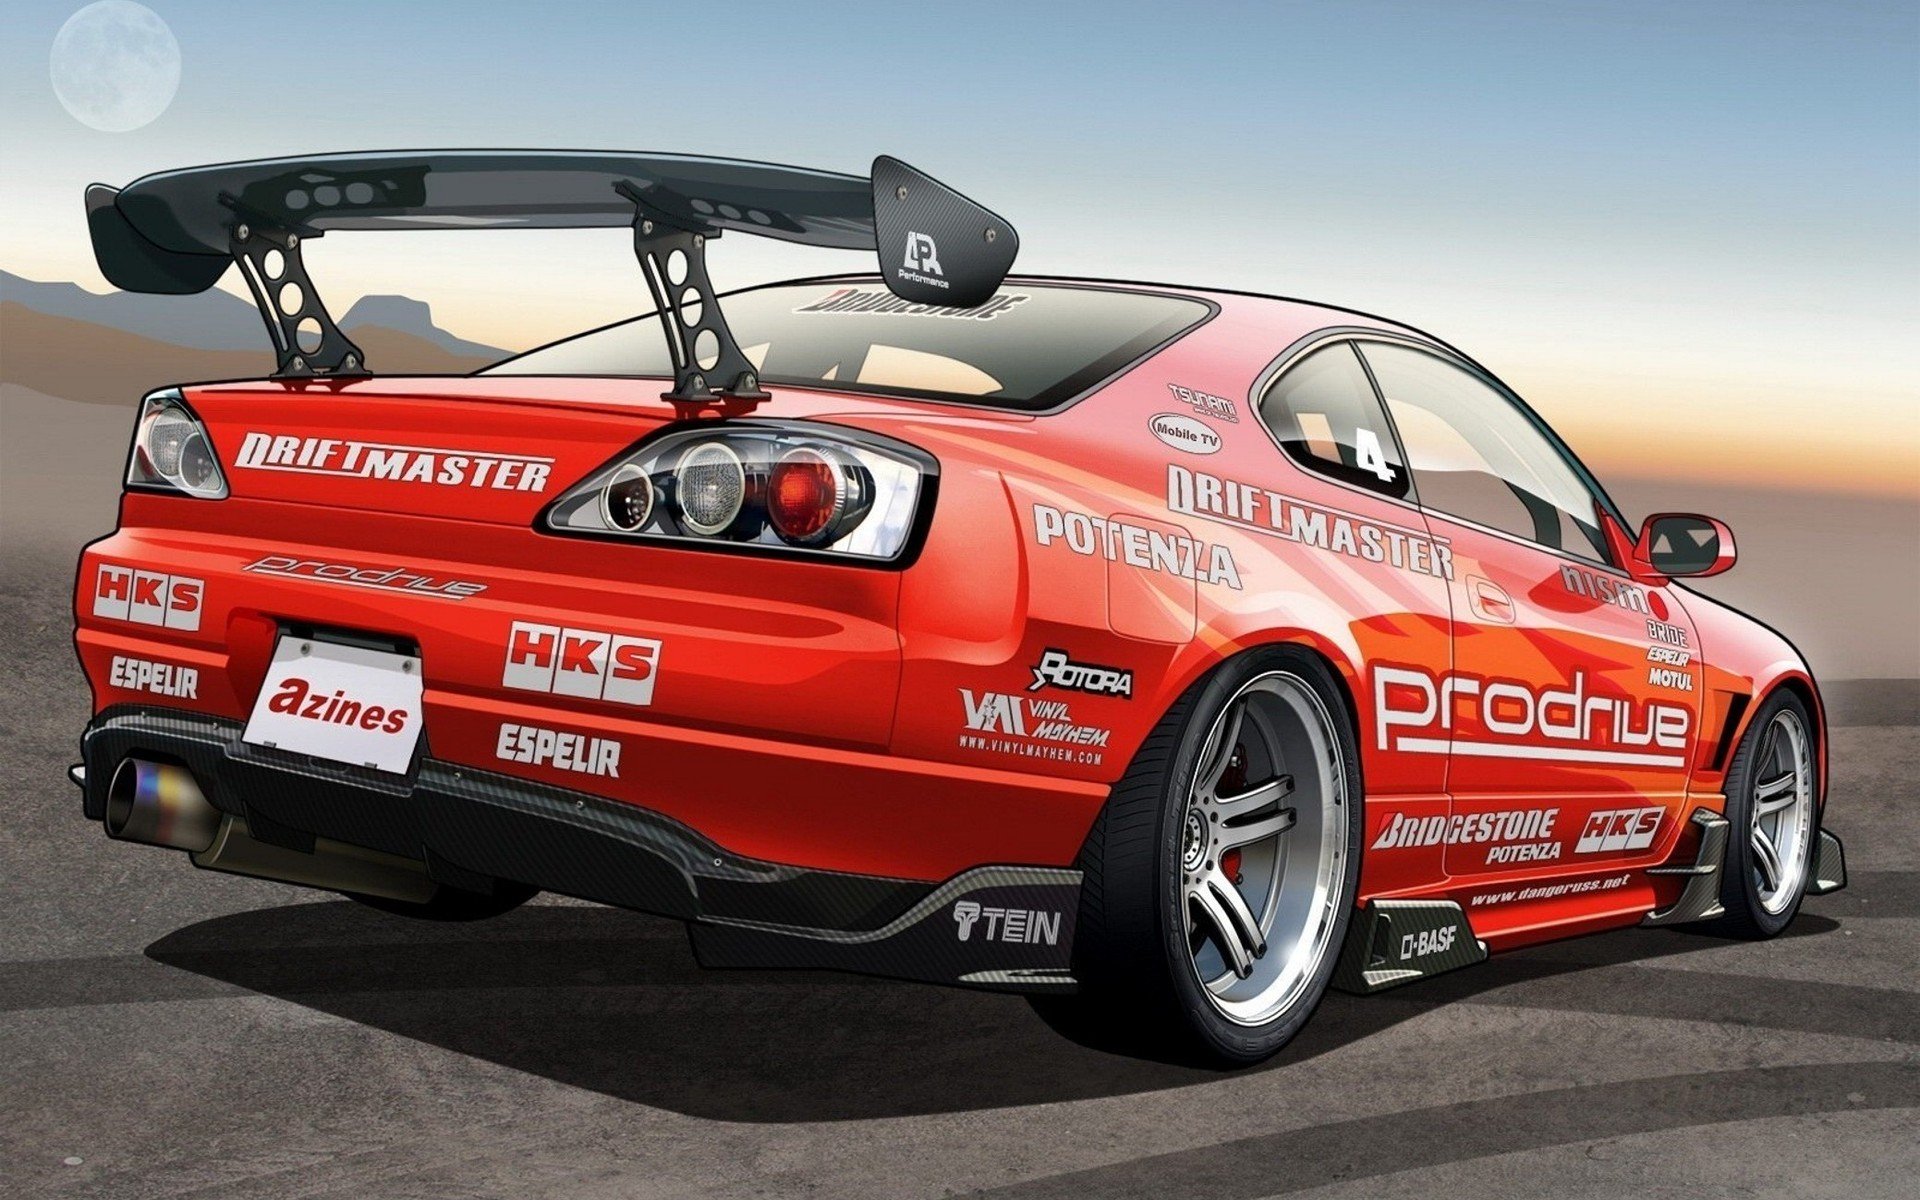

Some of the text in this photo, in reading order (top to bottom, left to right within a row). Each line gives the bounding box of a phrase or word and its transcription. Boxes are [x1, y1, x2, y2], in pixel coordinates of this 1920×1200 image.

[898, 269, 950, 290] Performance
[1157, 423, 1218, 446] Mobile TV
[234, 432, 555, 493] DRIFTMASTER
[1356, 427, 1397, 482] 4
[1167, 463, 1455, 581] DRIFTMASTER
[1033, 503, 1243, 590] POTENZA
[97, 566, 202, 615] HKS
[1647, 620, 1688, 648] BRIDE
[510, 625, 657, 684] HKS
[1029, 651, 1131, 695] ROTORA
[110, 655, 199, 700] ESPELIR
[1649, 668, 1693, 691] MOTUL
[268, 677, 408, 735] azines
[1029, 699, 1072, 722] VINYL
[496, 722, 622, 778] ESPELIR
[959, 735, 1102, 766] WWW.VINYLMAYHEM.COM
[1032, 721, 1110, 748] MAYHEM
[1370, 808, 1664, 850] BRIDGESTONE HKS
[1485, 842, 1562, 865] POTENZA
[1470, 873, 1632, 907] www.dangeruss.net
[982, 908, 1062, 945] TEIN
[1416, 925, 1457, 957] BASF
